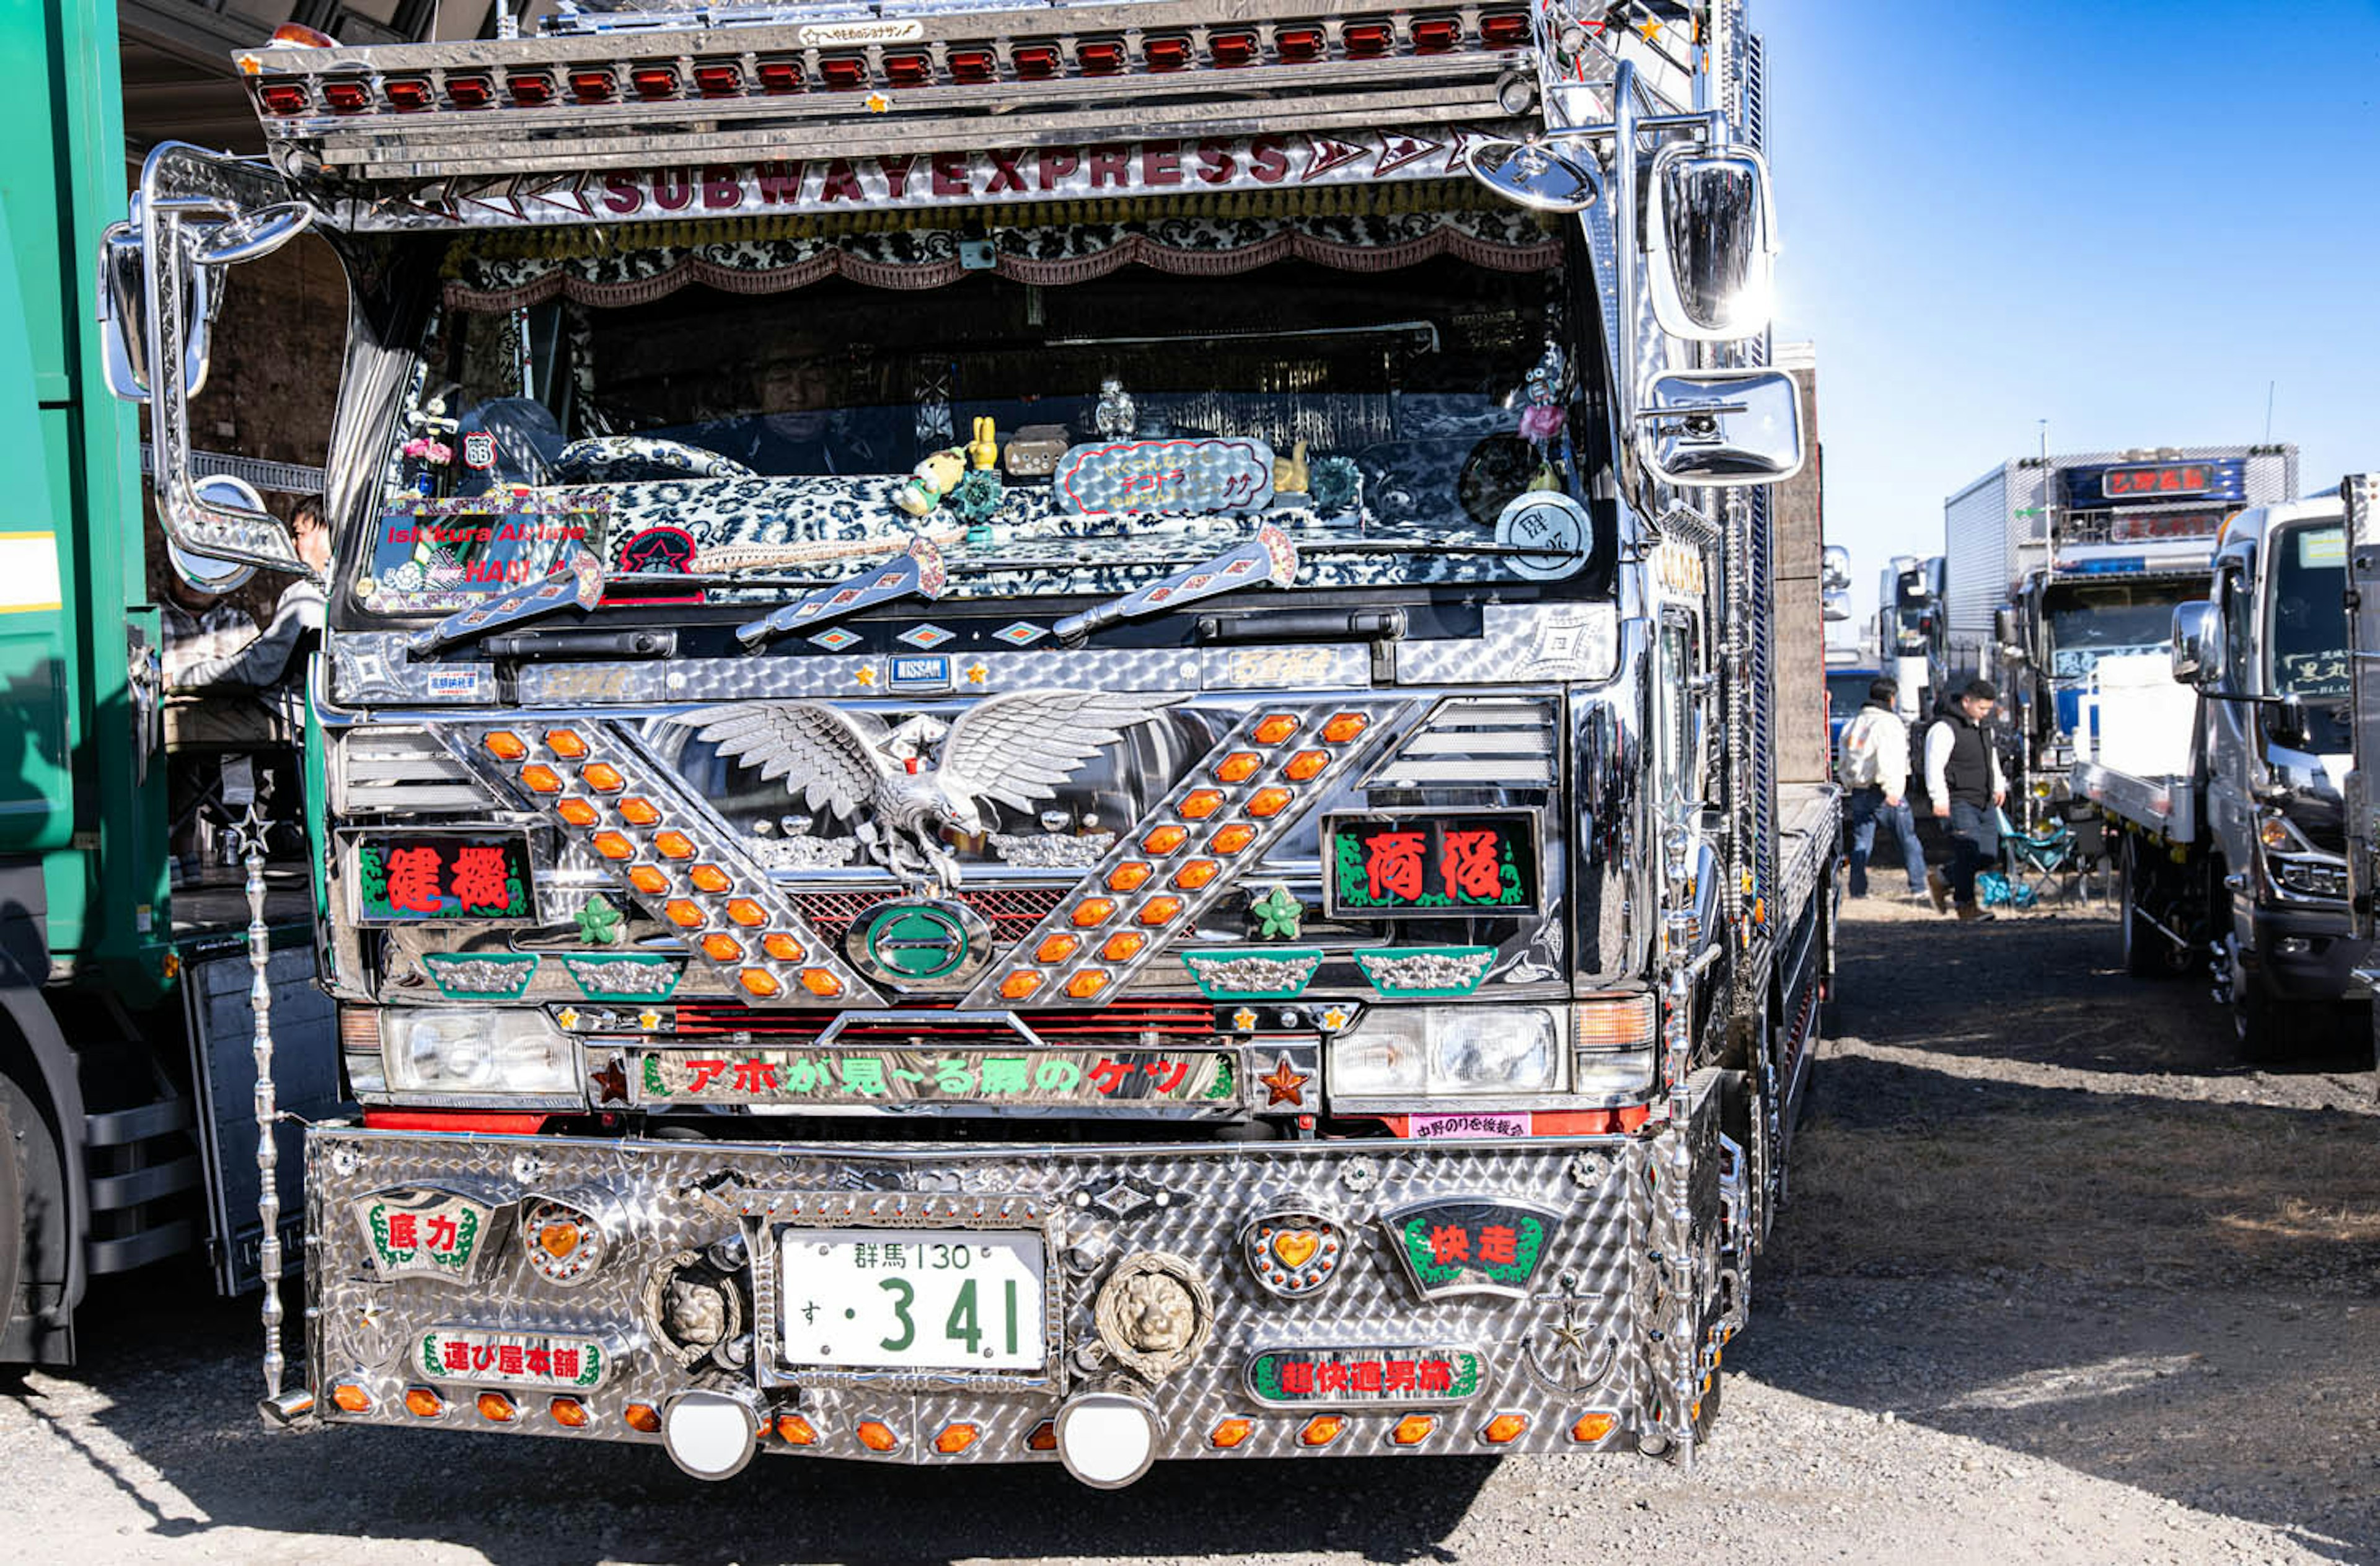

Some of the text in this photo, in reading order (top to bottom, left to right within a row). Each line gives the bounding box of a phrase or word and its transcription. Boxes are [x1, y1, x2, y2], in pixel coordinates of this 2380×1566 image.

[387, 525, 491, 544] Ishikura
[897, 659, 941, 679] NISSAN
[388, 1212, 457, 1251] 底力
[1429, 1223, 1518, 1265] 快走
[801, 1300, 821, 1326] す
[444, 1341, 580, 1378] 運び屋本舗
[1281, 1359, 1452, 1394] 超快適男旅
